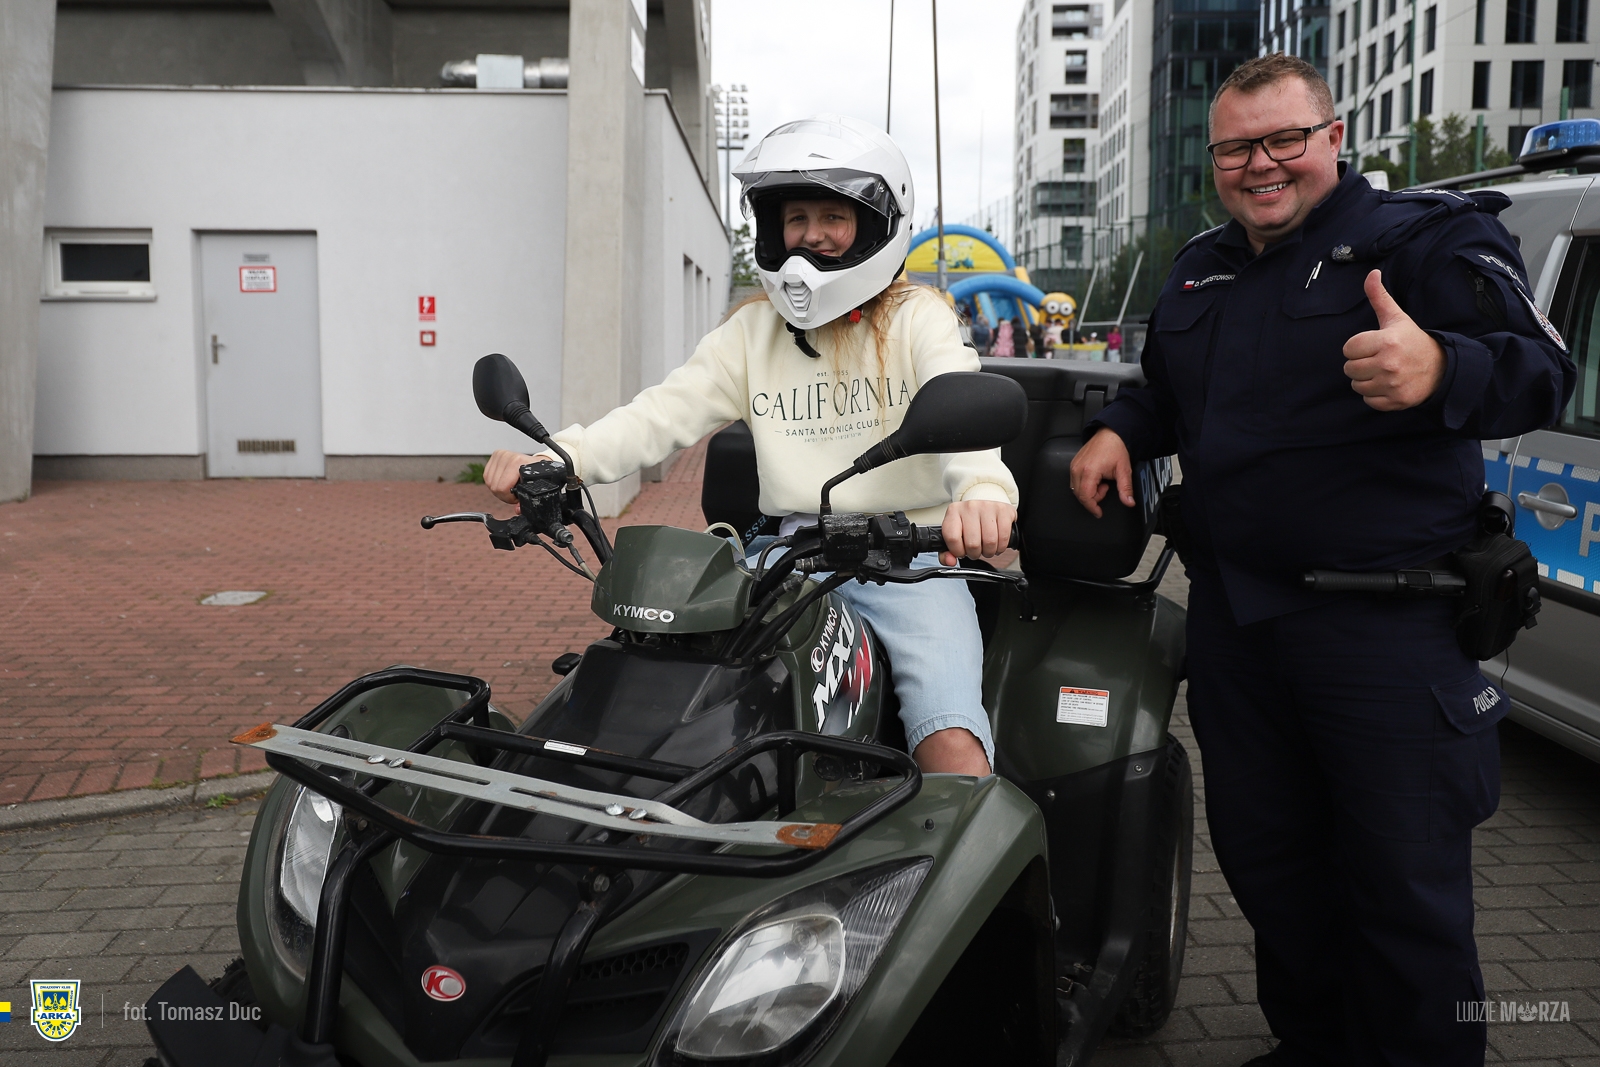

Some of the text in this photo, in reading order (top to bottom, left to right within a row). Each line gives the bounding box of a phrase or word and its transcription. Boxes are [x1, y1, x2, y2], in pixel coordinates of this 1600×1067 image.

[752, 377, 913, 421] CALIFORNIA
[785, 418, 880, 437] SANTA MONICA CLUB
[613, 603, 675, 623] KYMCO
[820, 606, 838, 651] KYMCO
[813, 601, 856, 733] MXU
